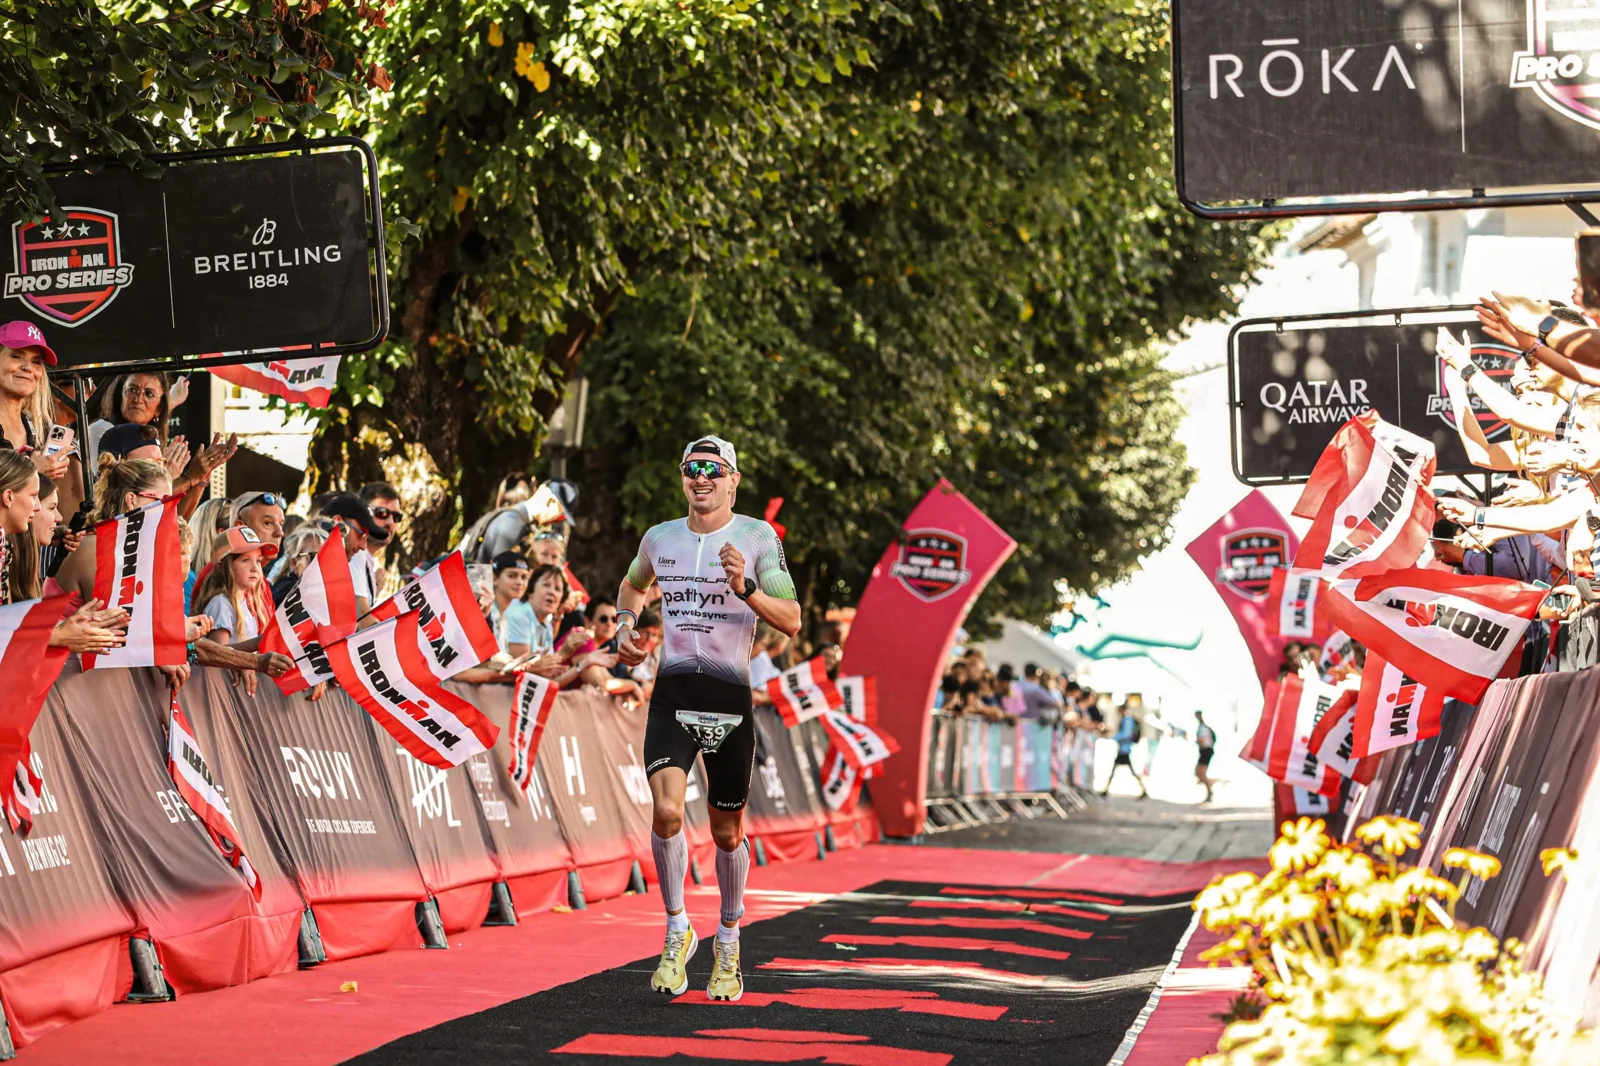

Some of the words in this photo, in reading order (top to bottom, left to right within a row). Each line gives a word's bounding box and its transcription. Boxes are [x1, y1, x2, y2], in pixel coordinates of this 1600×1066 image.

[1517, 54, 1583, 81] PRO
[31, 249, 106, 272] IRONMAN
[194, 244, 342, 274] BREITLING
[8, 272, 51, 294] PRO
[55, 267, 130, 289] SERIES
[248, 272, 289, 290] 1884
[1259, 378, 1370, 413] QATAR
[1430, 397, 1453, 411] PR
[663, 587, 725, 609] pattyn
[357, 639, 462, 750] IRONMAN
[280, 745, 361, 800] ROUVY
